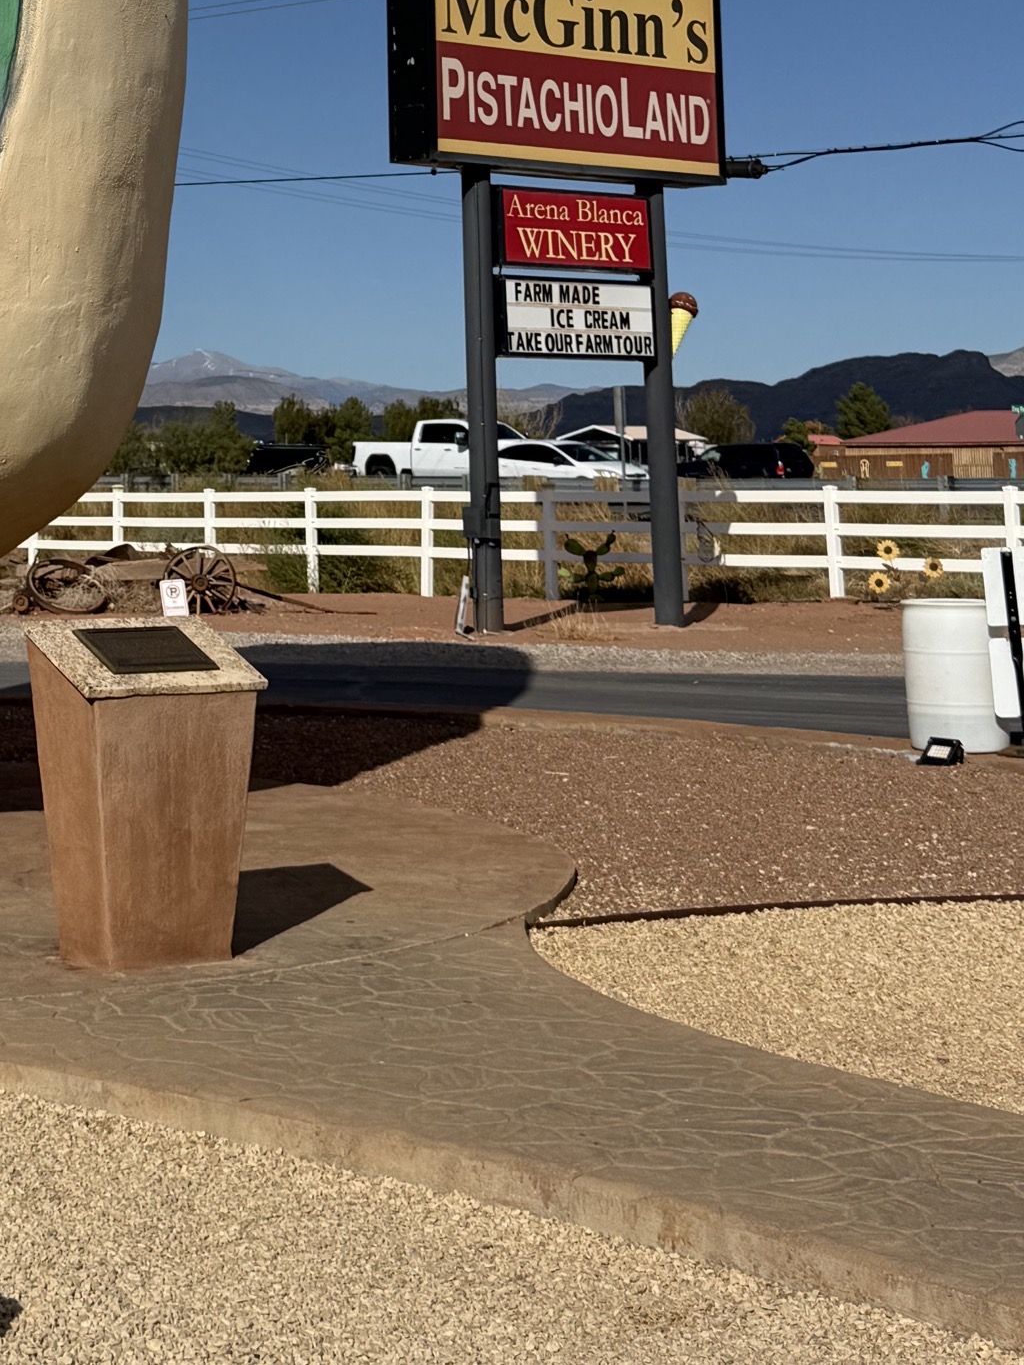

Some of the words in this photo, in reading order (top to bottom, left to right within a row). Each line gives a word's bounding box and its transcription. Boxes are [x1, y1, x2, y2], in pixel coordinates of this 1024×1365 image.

[507, 194, 570, 221] Arena
[576, 199, 644, 226] Blanca
[516, 227, 636, 262] WINERY
[514, 282, 553, 303] FARM
[559, 284, 600, 305] MADE
[550, 308, 574, 328] ICE
[584, 310, 631, 330] CREAM
[507, 331, 542, 352] TAKE
[544, 333, 574, 353] OUR
[576, 334, 613, 354] FARM
[614, 335, 653, 355] TOUR
